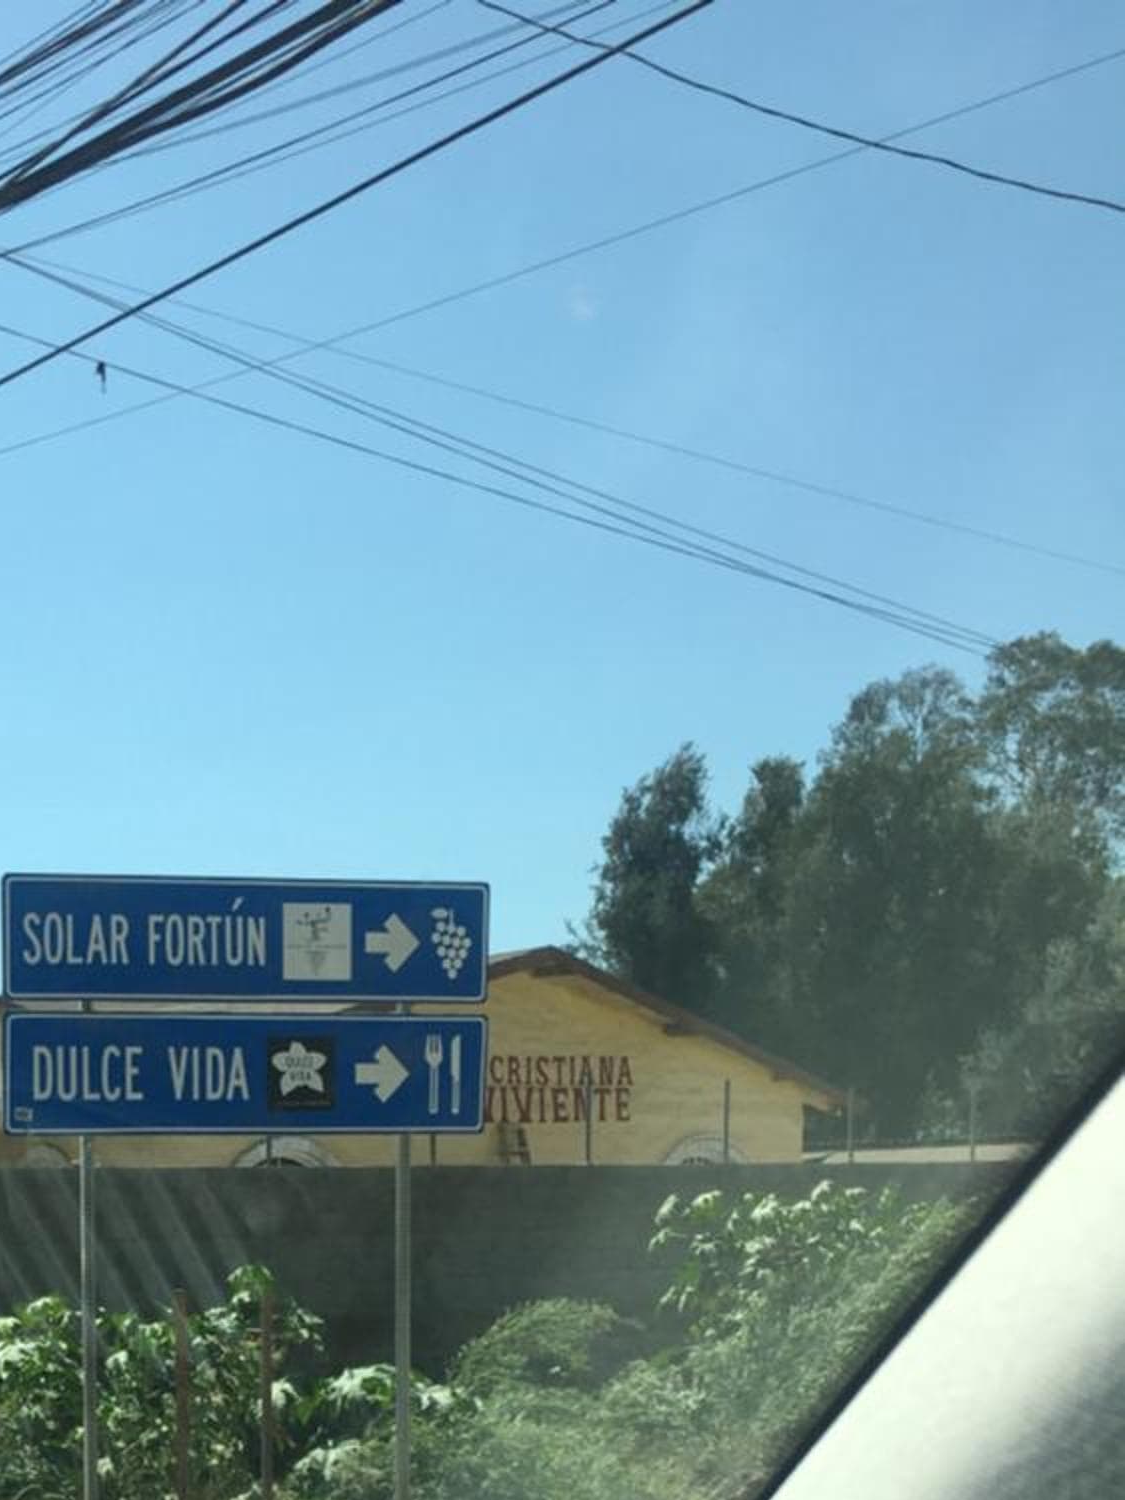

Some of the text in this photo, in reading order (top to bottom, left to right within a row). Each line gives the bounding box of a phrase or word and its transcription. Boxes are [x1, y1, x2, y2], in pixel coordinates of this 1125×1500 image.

[23, 896, 266, 967] SOLAR FORTÚN
[32, 1045, 250, 1101] DULCE VIDA
[489, 1055, 633, 1086] CRISTIANA
